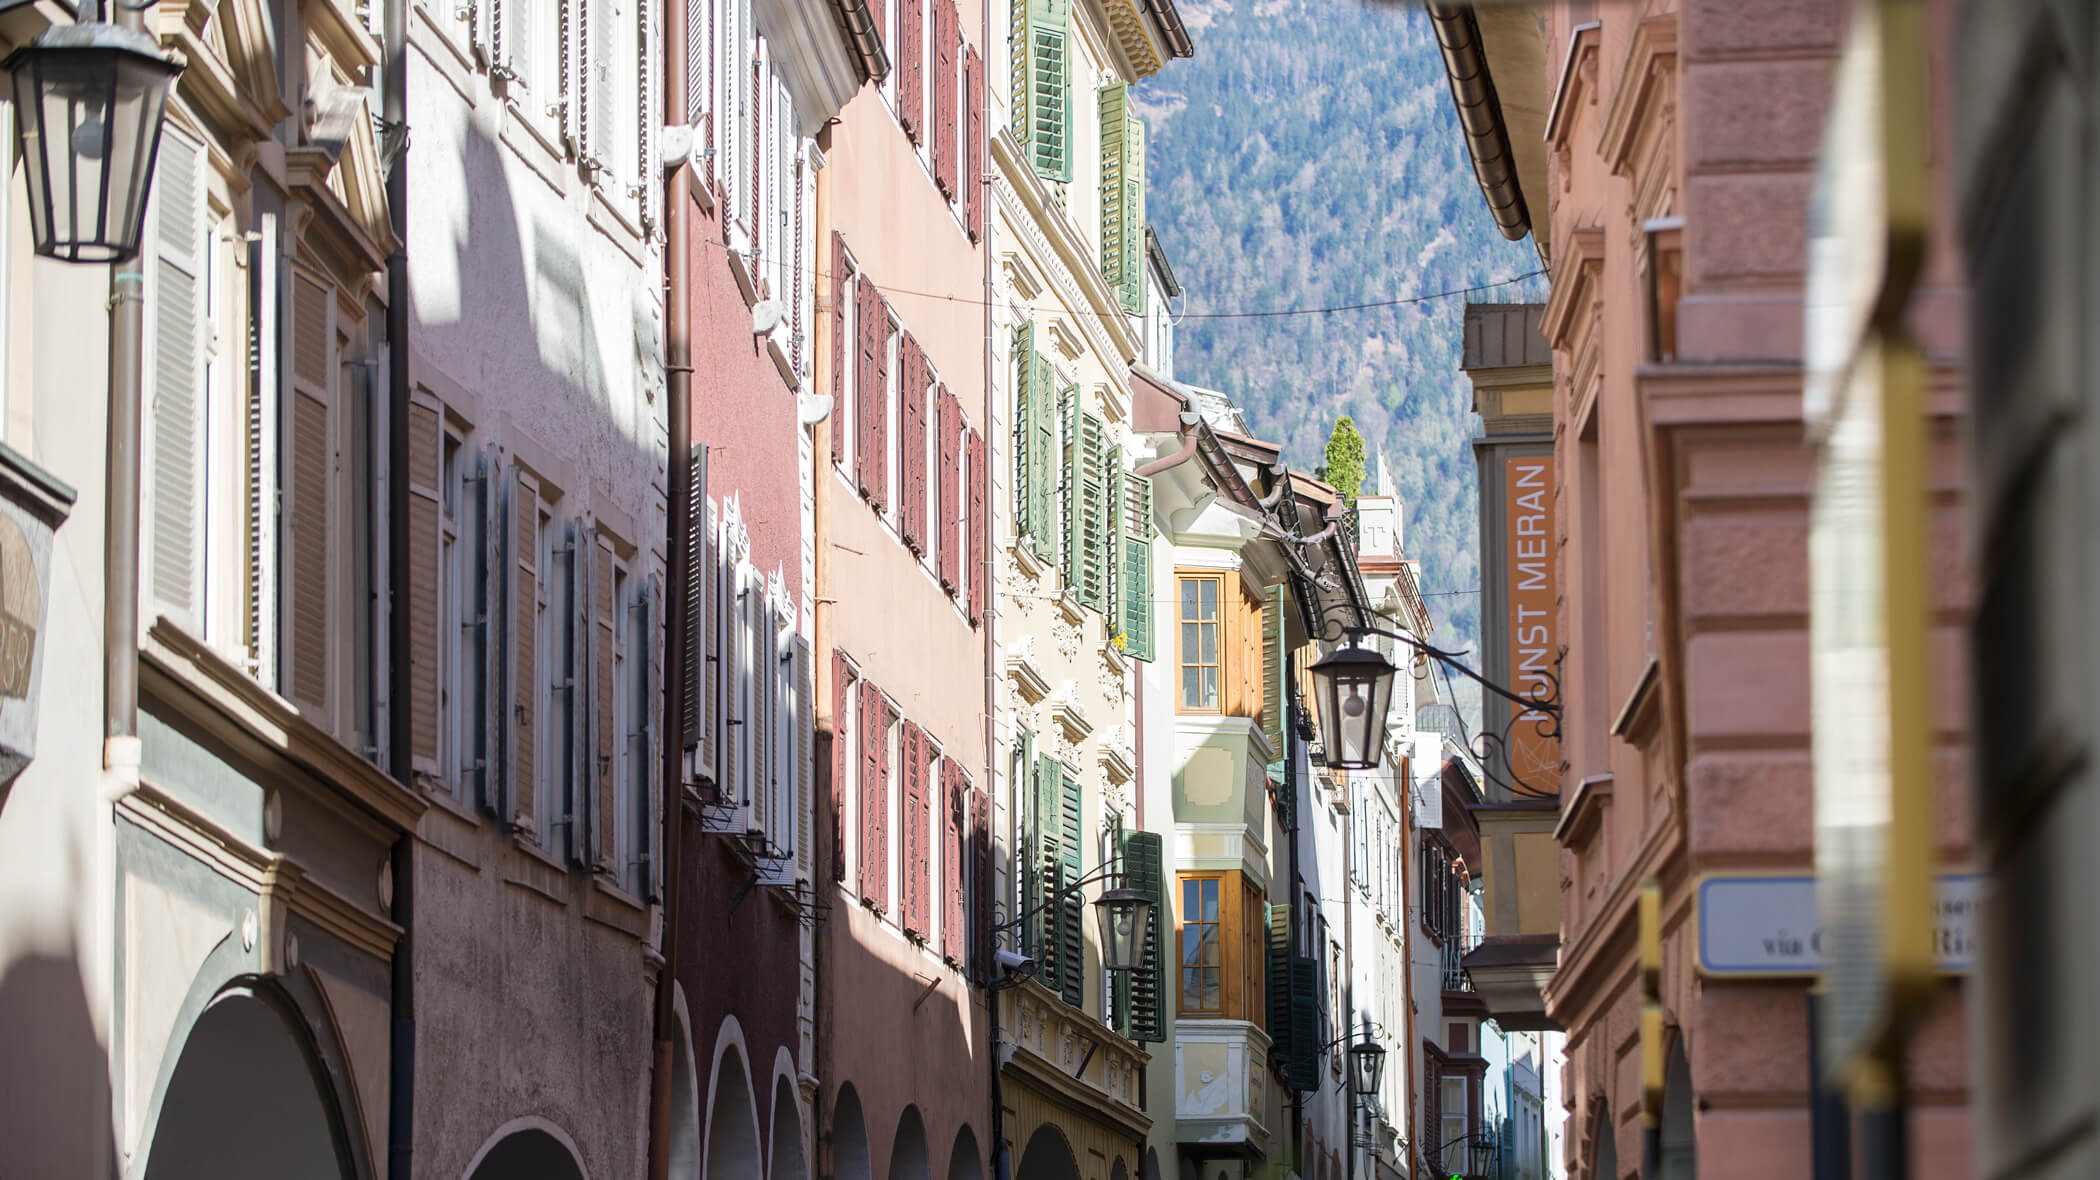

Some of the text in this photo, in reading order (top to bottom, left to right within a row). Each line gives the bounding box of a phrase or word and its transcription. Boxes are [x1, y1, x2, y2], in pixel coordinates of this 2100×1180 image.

[1516, 465, 1548, 721] KUNST MERAN
[1762, 928, 1803, 956] via
